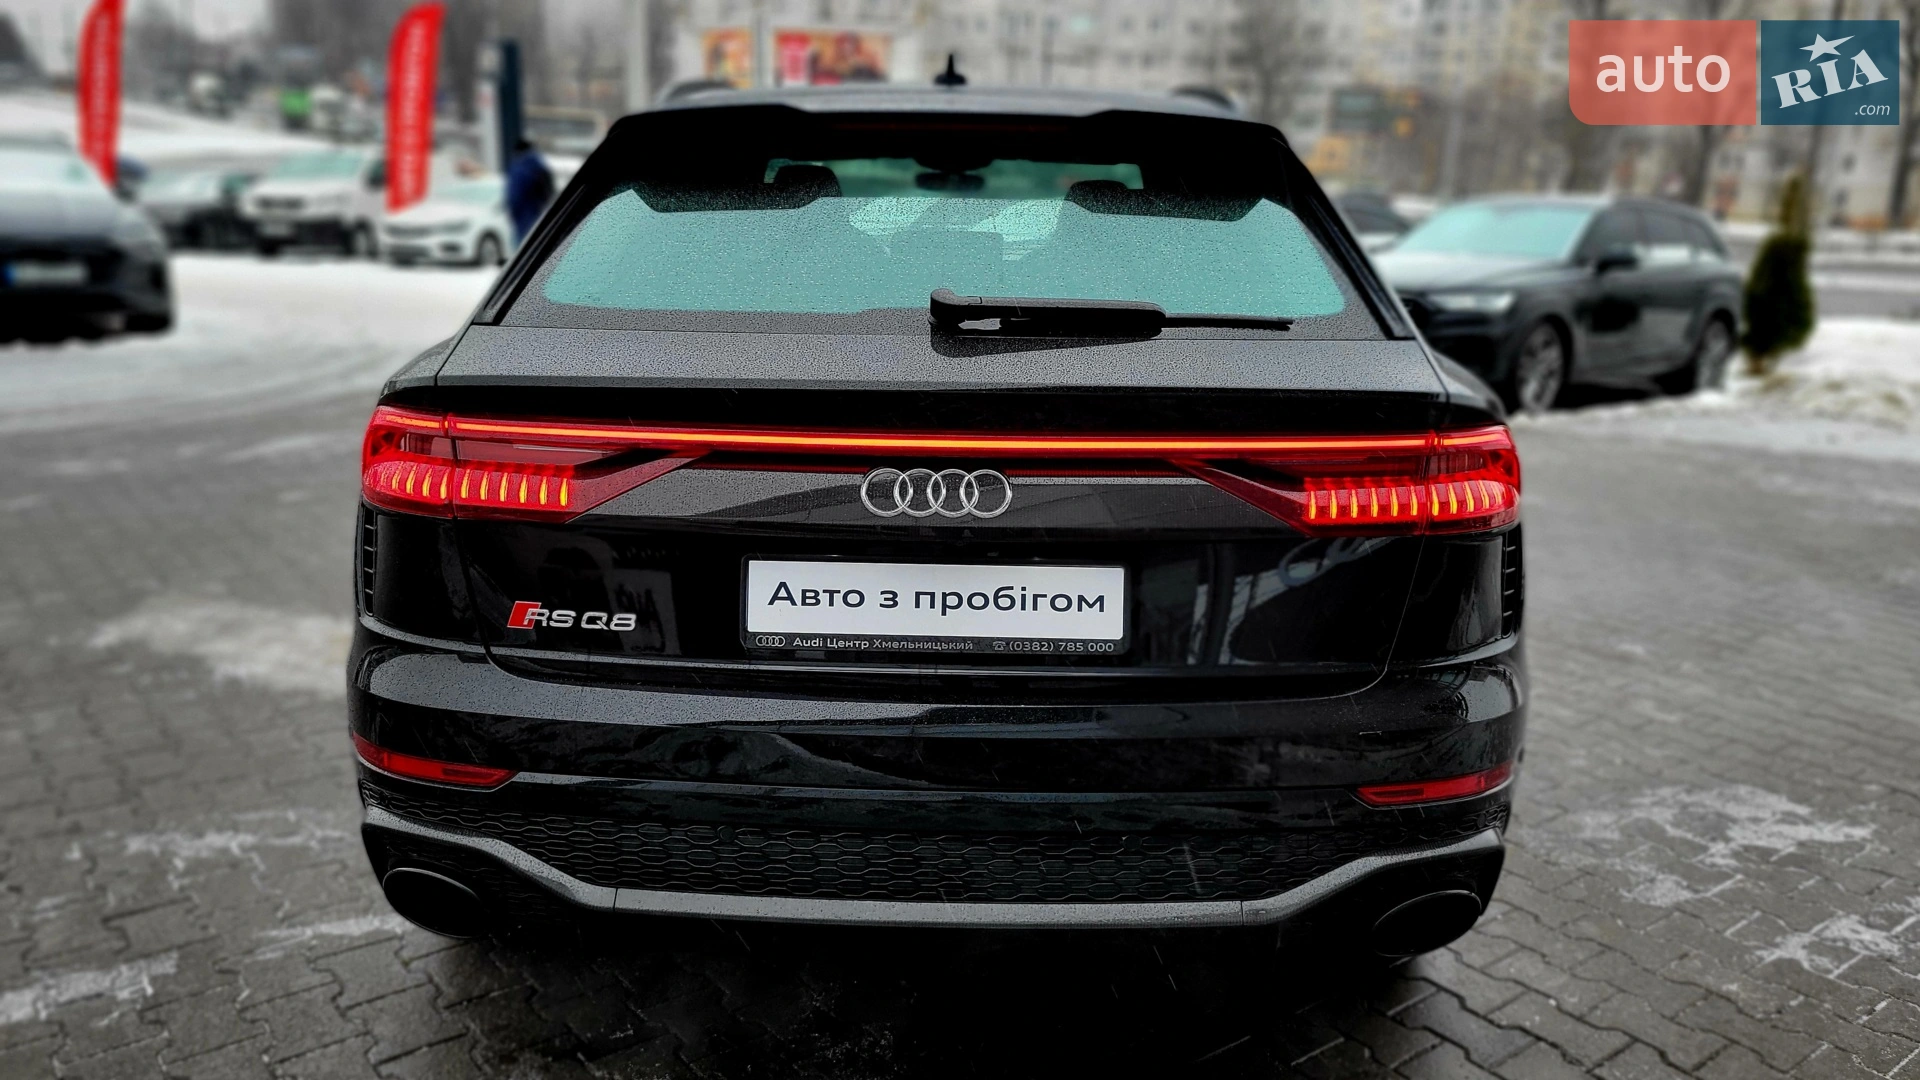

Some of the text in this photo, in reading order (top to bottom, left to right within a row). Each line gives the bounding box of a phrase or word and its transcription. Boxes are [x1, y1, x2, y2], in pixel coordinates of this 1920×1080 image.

[767, 581, 1106, 616] Авто з пробігом
[522, 608, 637, 632] RS Q8
[793, 637, 973, 651] Audi Центр Хмельницький
[1009, 641, 1114, 652] (0382) 785 000
